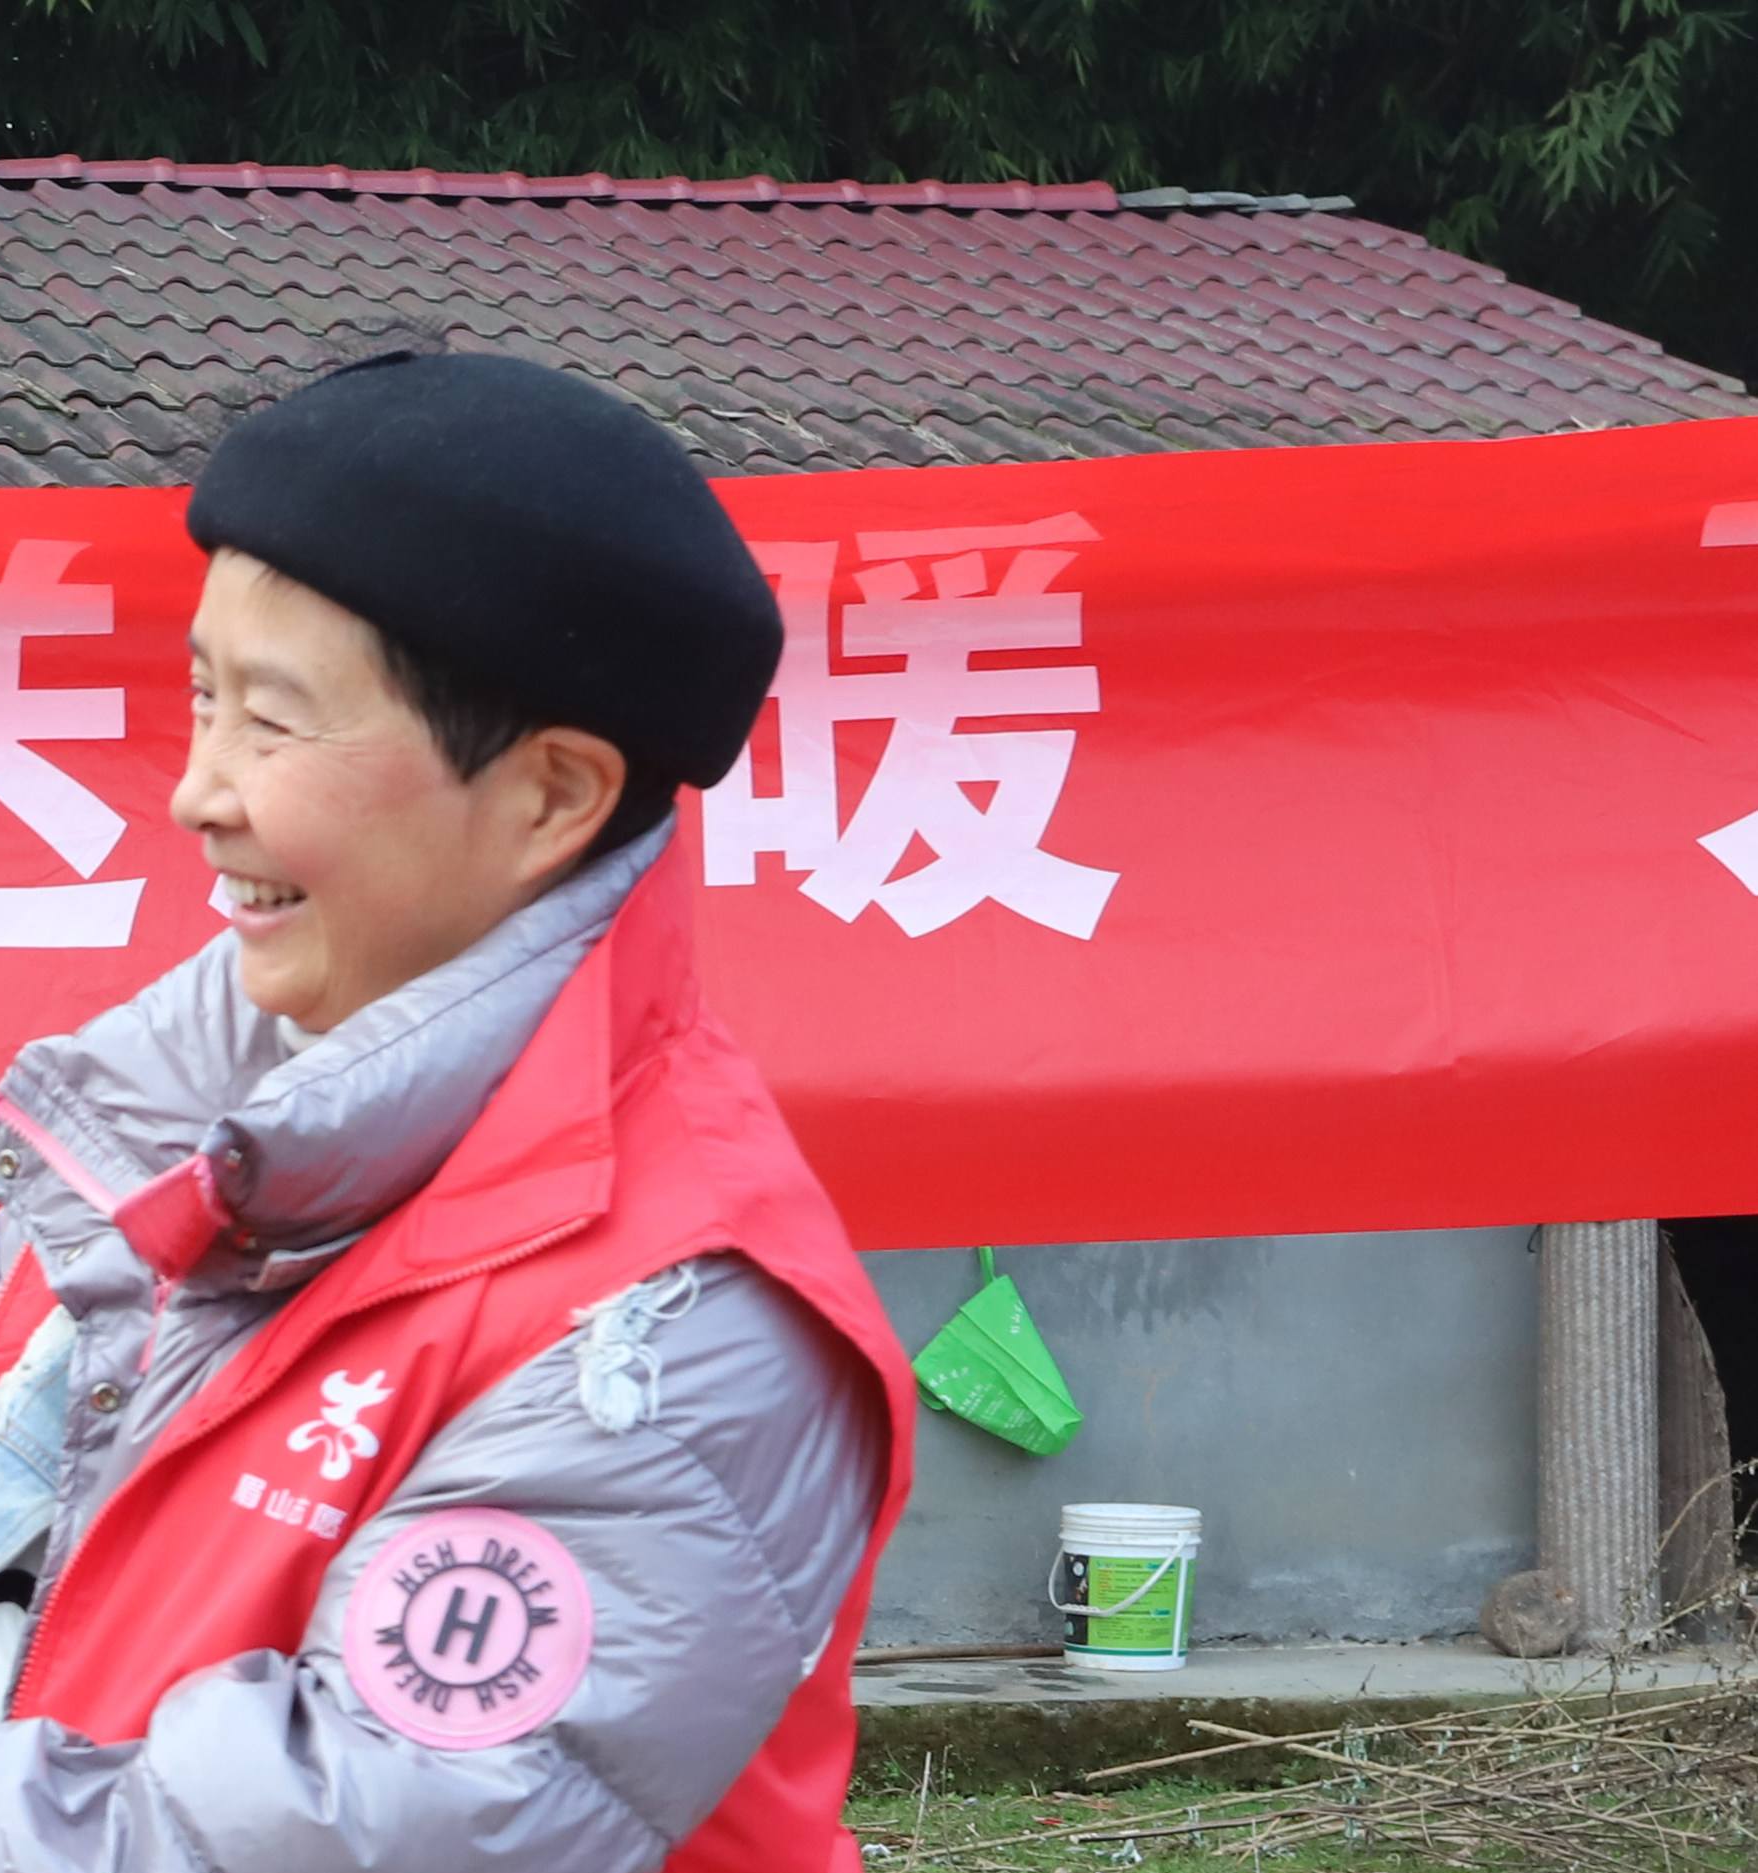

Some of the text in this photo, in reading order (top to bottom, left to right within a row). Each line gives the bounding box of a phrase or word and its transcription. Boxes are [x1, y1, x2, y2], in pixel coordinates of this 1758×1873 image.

[392, 1539, 457, 1596] HSH
[433, 1586, 499, 1665] H
[475, 1657, 542, 1711] HSH
